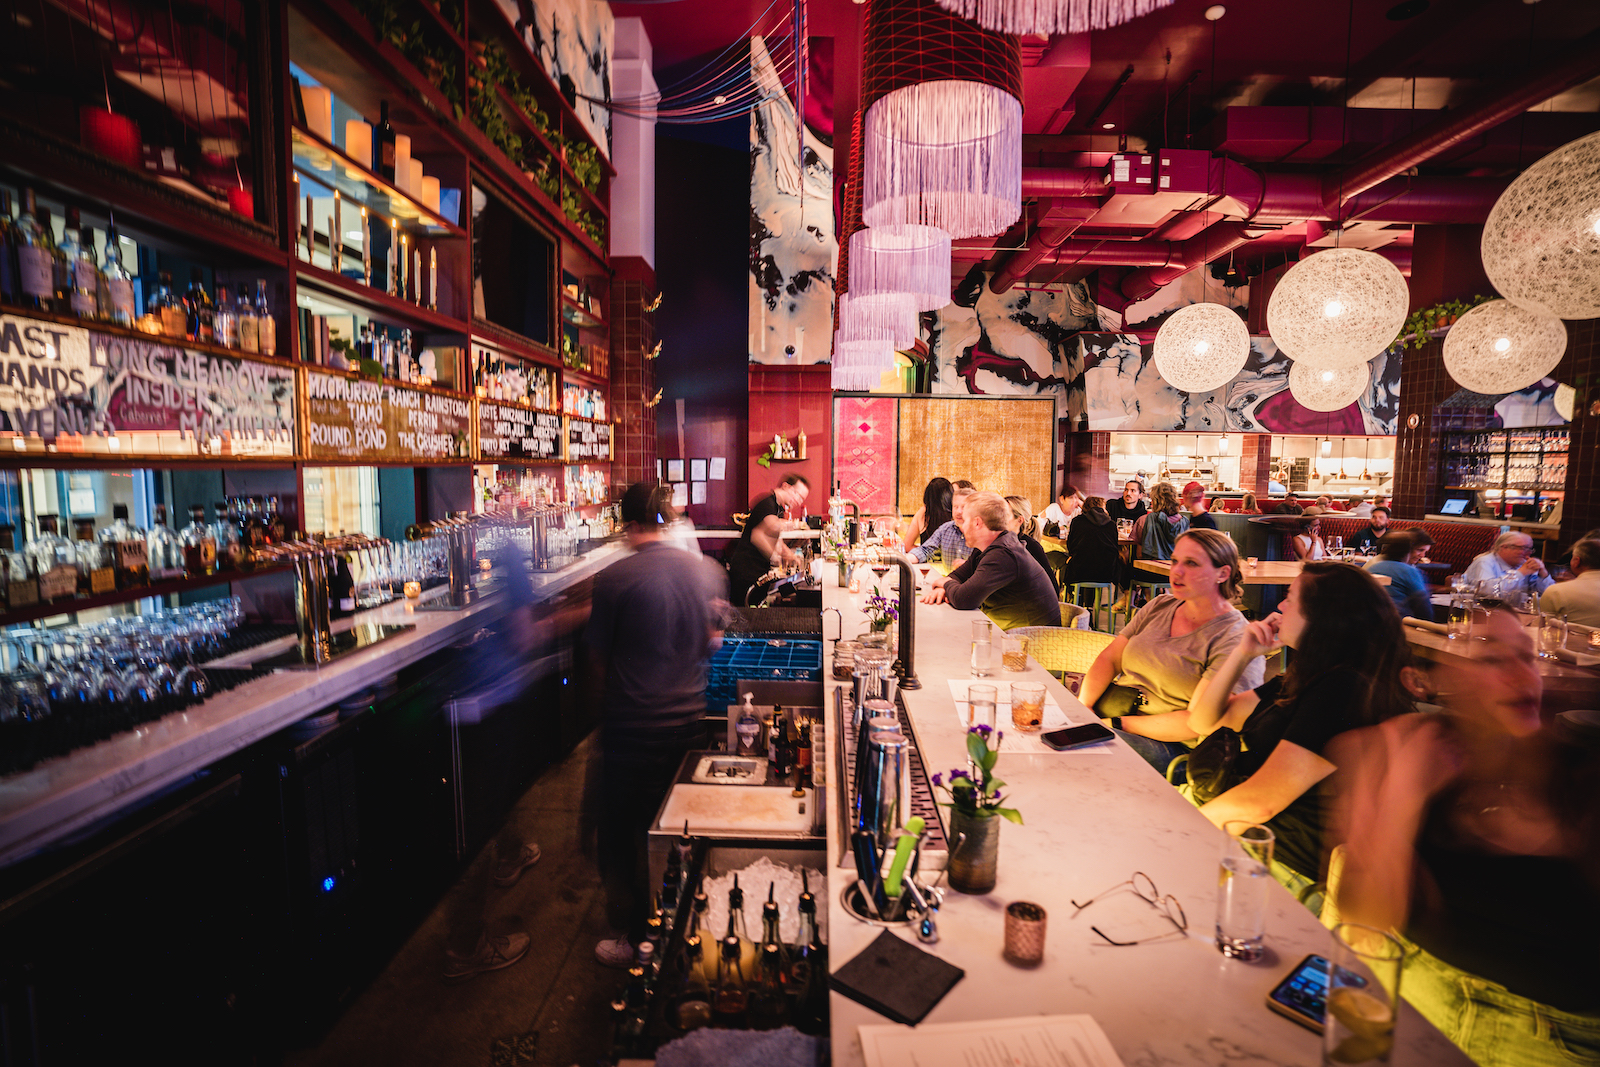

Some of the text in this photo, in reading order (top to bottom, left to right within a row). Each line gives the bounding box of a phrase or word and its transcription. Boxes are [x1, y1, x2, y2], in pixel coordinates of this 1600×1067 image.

[89, 331, 269, 395] LONG MEADOW
[0, 361, 88, 397] ANDS
[308, 372, 420, 409] MACMURRAY RANCH
[125, 374, 211, 413] INSIDER
[424, 393, 469, 419] RAINSTORM
[119, 401, 169, 427] Cabernet
[347, 402, 383, 425] TIAMO
[408, 409, 438, 430] PERRIN
[499, 407, 534, 426] MANZANILLA
[180, 409, 295, 446] MARTIN RAY
[310, 421, 352, 447] ROUND
[355, 427, 387, 450] POND
[398, 431, 415, 451] THE
[416, 431, 455, 455] CRUSHER
